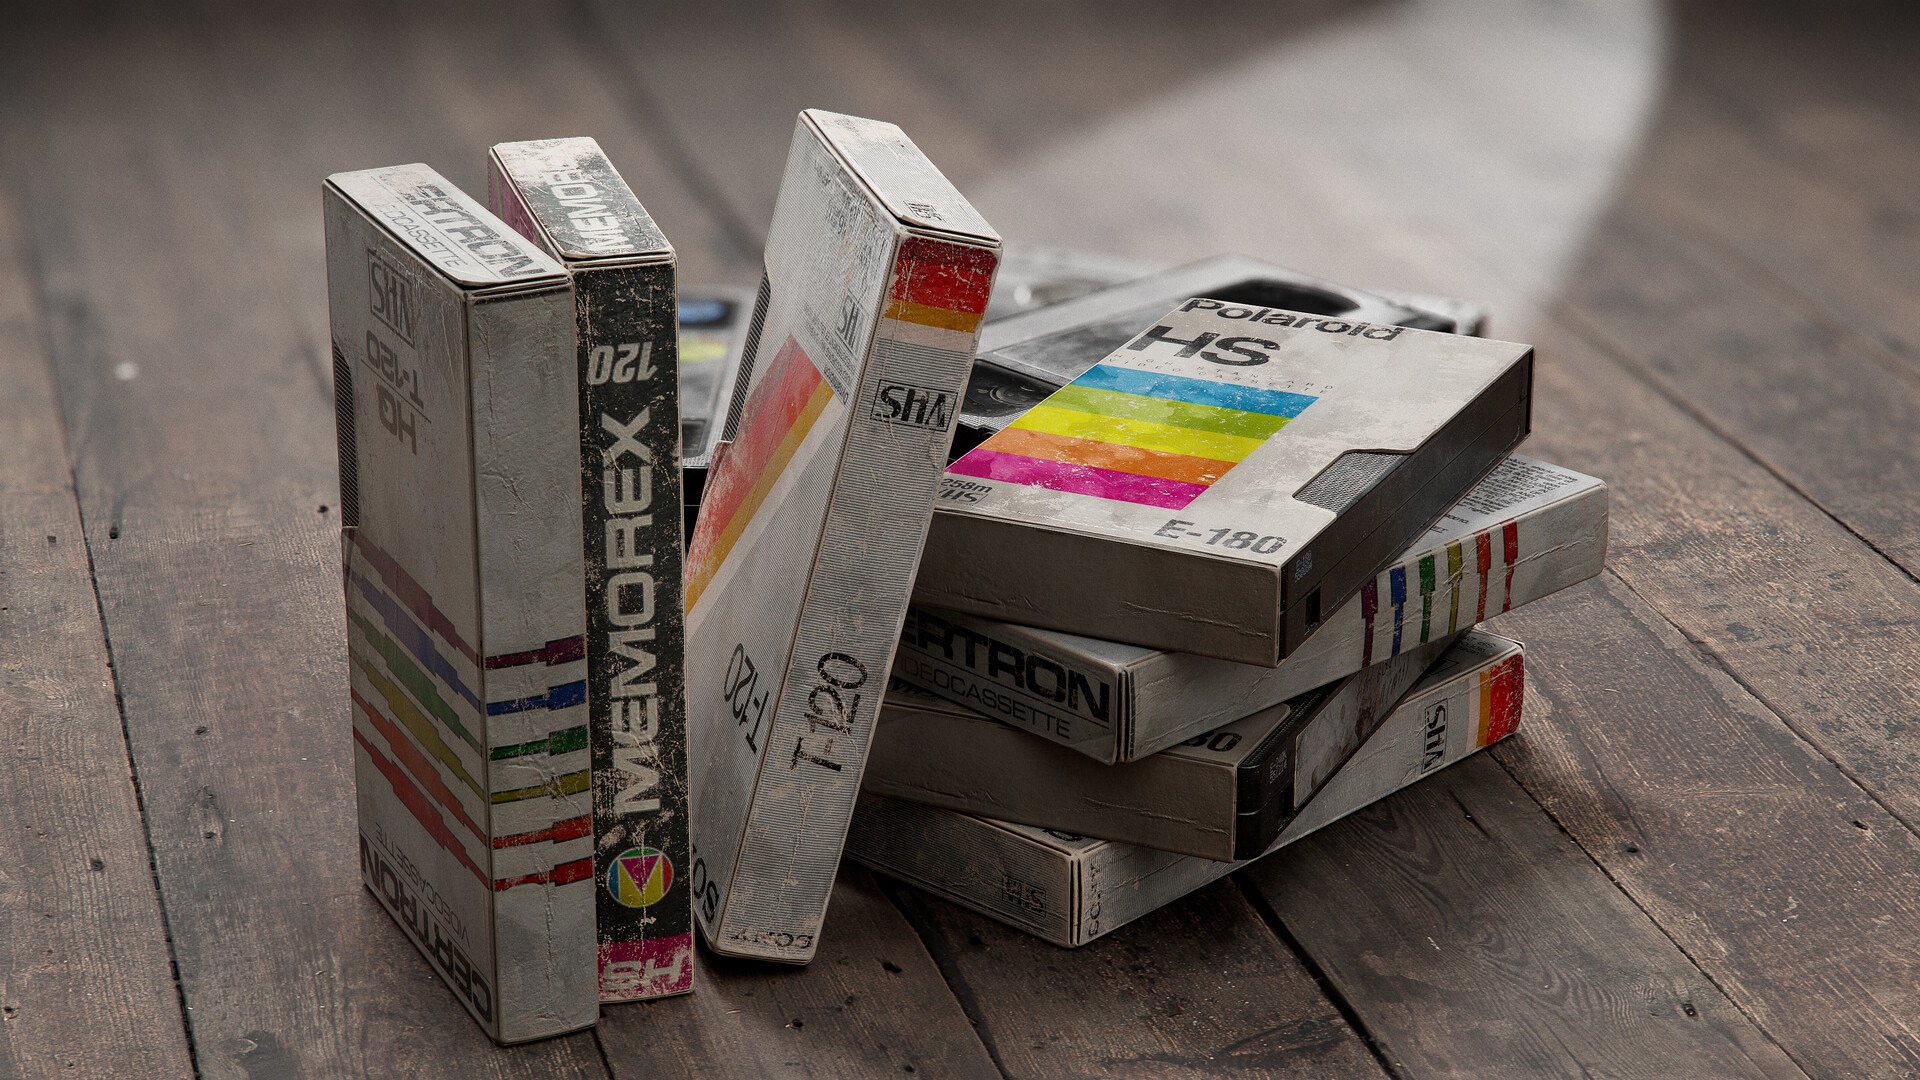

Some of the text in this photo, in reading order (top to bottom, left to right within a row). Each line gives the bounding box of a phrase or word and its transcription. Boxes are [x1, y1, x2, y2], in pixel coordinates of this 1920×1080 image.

[401, 182, 547, 278] ERTRON
[545, 163, 634, 253] MEMOR
[370, 260, 413, 340] VHS
[1179, 299, 1405, 341] Polaroid
[366, 329, 424, 410] T-120
[587, 341, 658, 385] 120
[1108, 358, 1182, 373] VIDEO
[1113, 353, 1174, 367] HIGH
[1126, 325, 1281, 367] HS
[375, 382, 418, 457] HQ
[879, 384, 947, 429] VHS
[940, 478, 993, 493] 258m
[1153, 518, 1287, 555] E-180
[600, 405, 662, 814] MEMOREX
[723, 642, 770, 755] T-120
[790, 652, 868, 772] T-120
[902, 656, 1071, 740] IDEOCASSETTE
[1423, 704, 1446, 770] VHS
[375, 821, 471, 949] VIDEOCASSETTE
[360, 832, 493, 1023] CERTRON
[601, 951, 688, 991] HS
